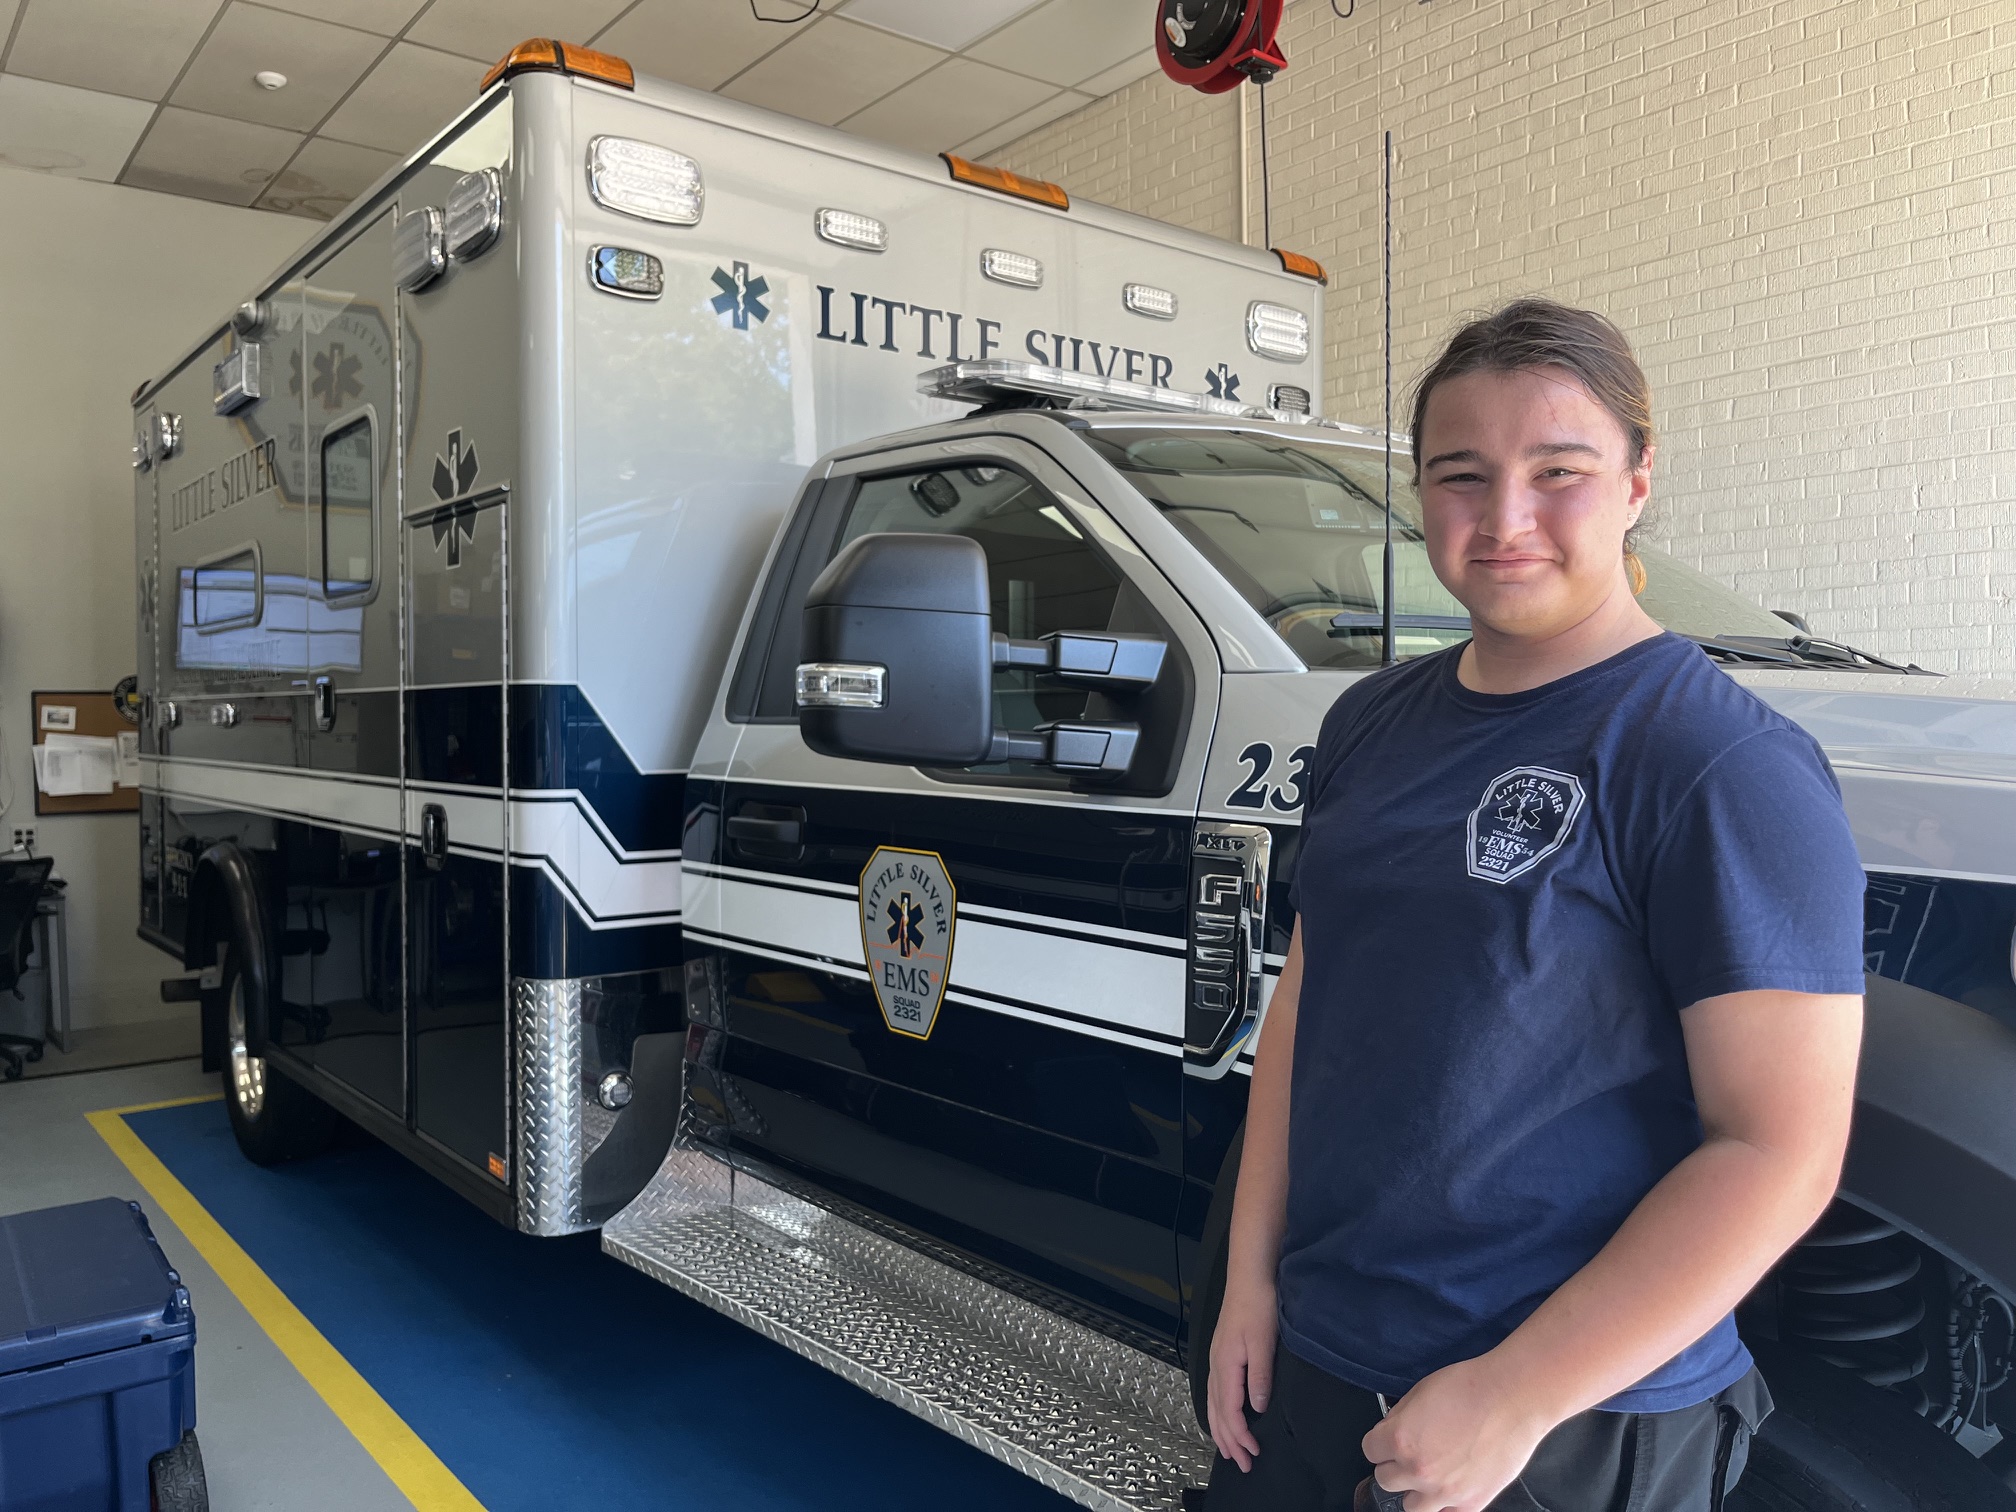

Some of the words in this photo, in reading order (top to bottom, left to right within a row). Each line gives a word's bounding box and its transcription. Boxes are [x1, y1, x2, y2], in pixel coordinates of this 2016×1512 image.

[816, 285, 1001, 363] LITTLE
[171, 470, 215, 532] LITTLE
[221, 438, 277, 509] SILVER
[1495, 778, 1537, 801] LITTLE
[1538, 781, 1564, 814] SILVER
[1206, 838, 1246, 851] XLT
[1478, 835, 1489, 844] 19
[1485, 835, 1525, 855] EMS
[1492, 829, 1529, 843] VOLUNTEER
[1484, 847, 1515, 860] SQUAD
[1478, 855, 1510, 872] 2321
[867, 862, 905, 922] LITTLE
[910, 864, 947, 935] SILVER
[883, 961, 930, 997] EMS
[893, 994, 921, 1009] SQUAD
[893, 1005, 922, 1022] 2321
